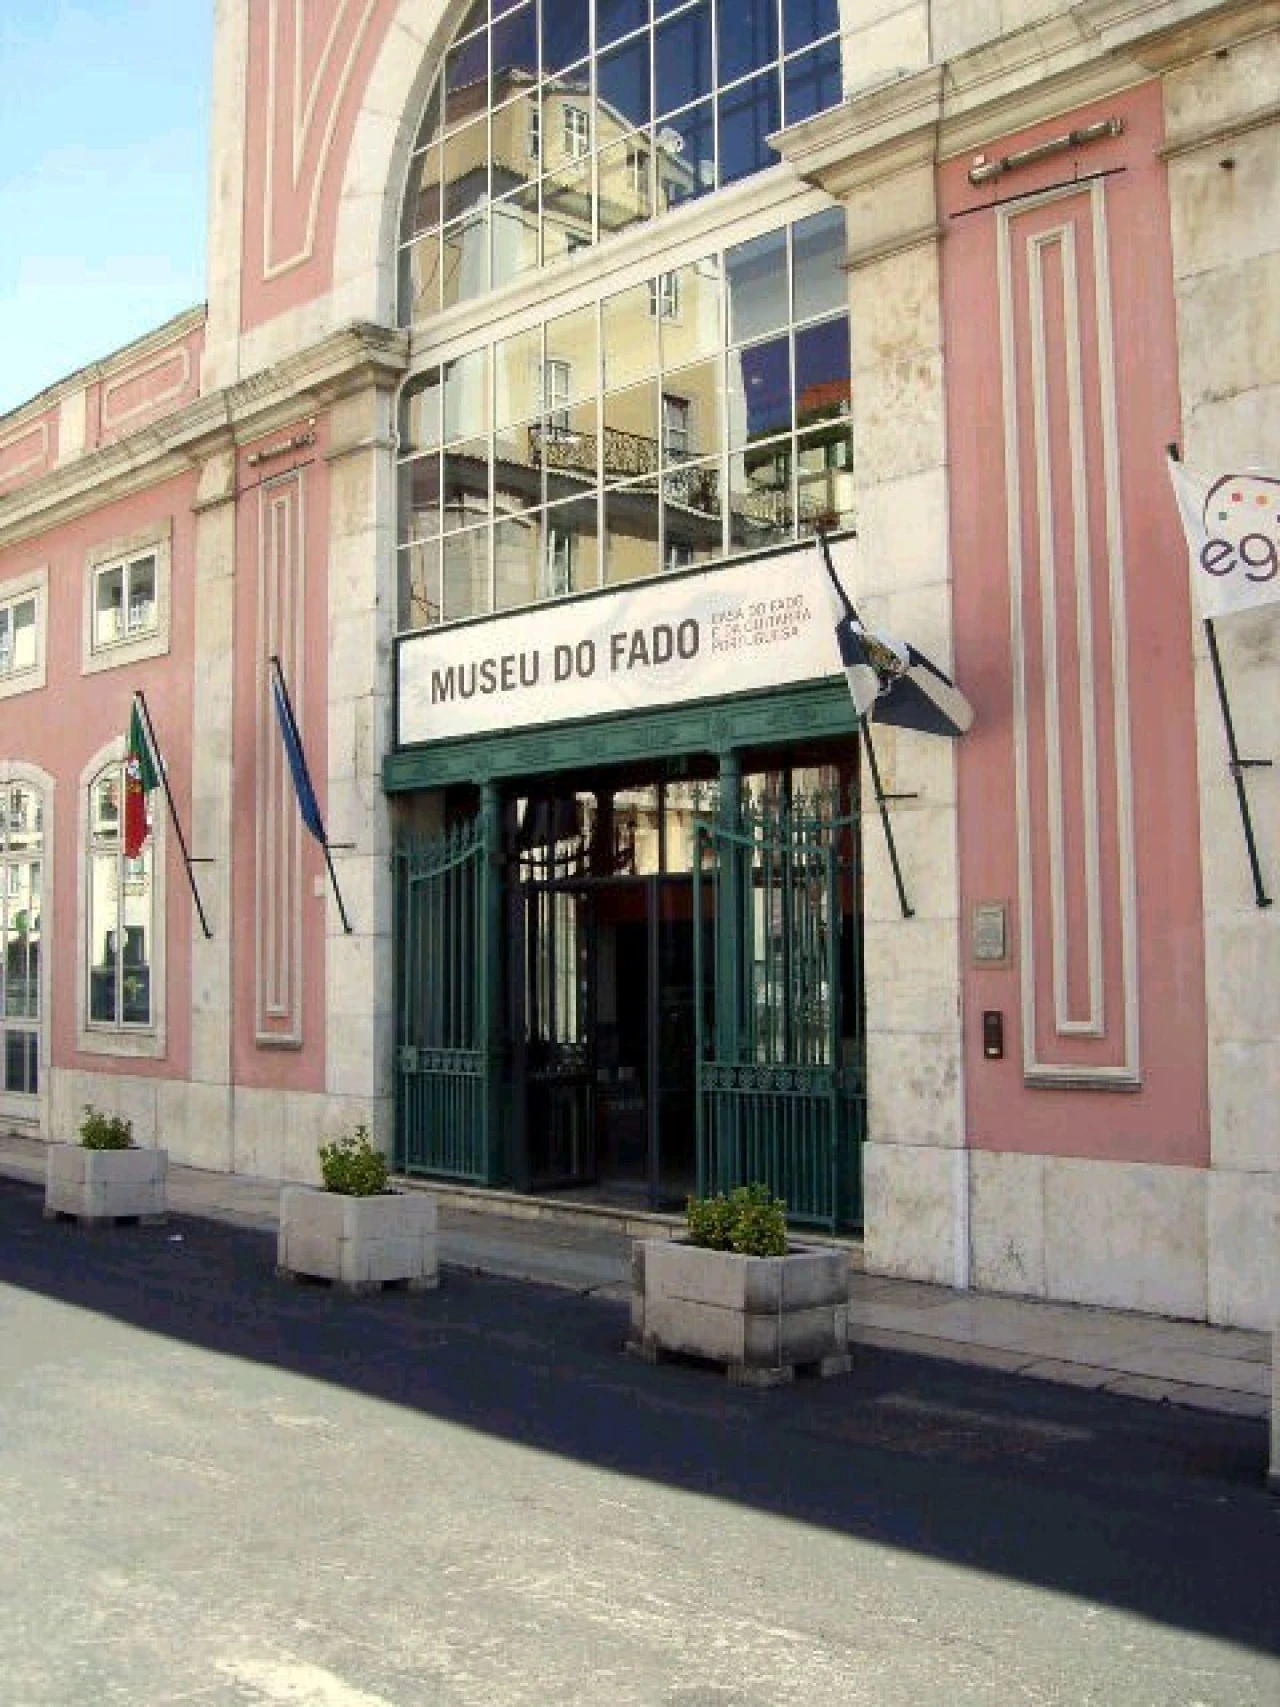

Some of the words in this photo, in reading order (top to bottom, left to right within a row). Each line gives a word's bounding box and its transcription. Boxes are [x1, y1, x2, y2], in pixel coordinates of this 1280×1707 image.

[432, 650, 539, 705] MUSEU
[554, 639, 596, 682] DO
[610, 618, 700, 672] FADO
